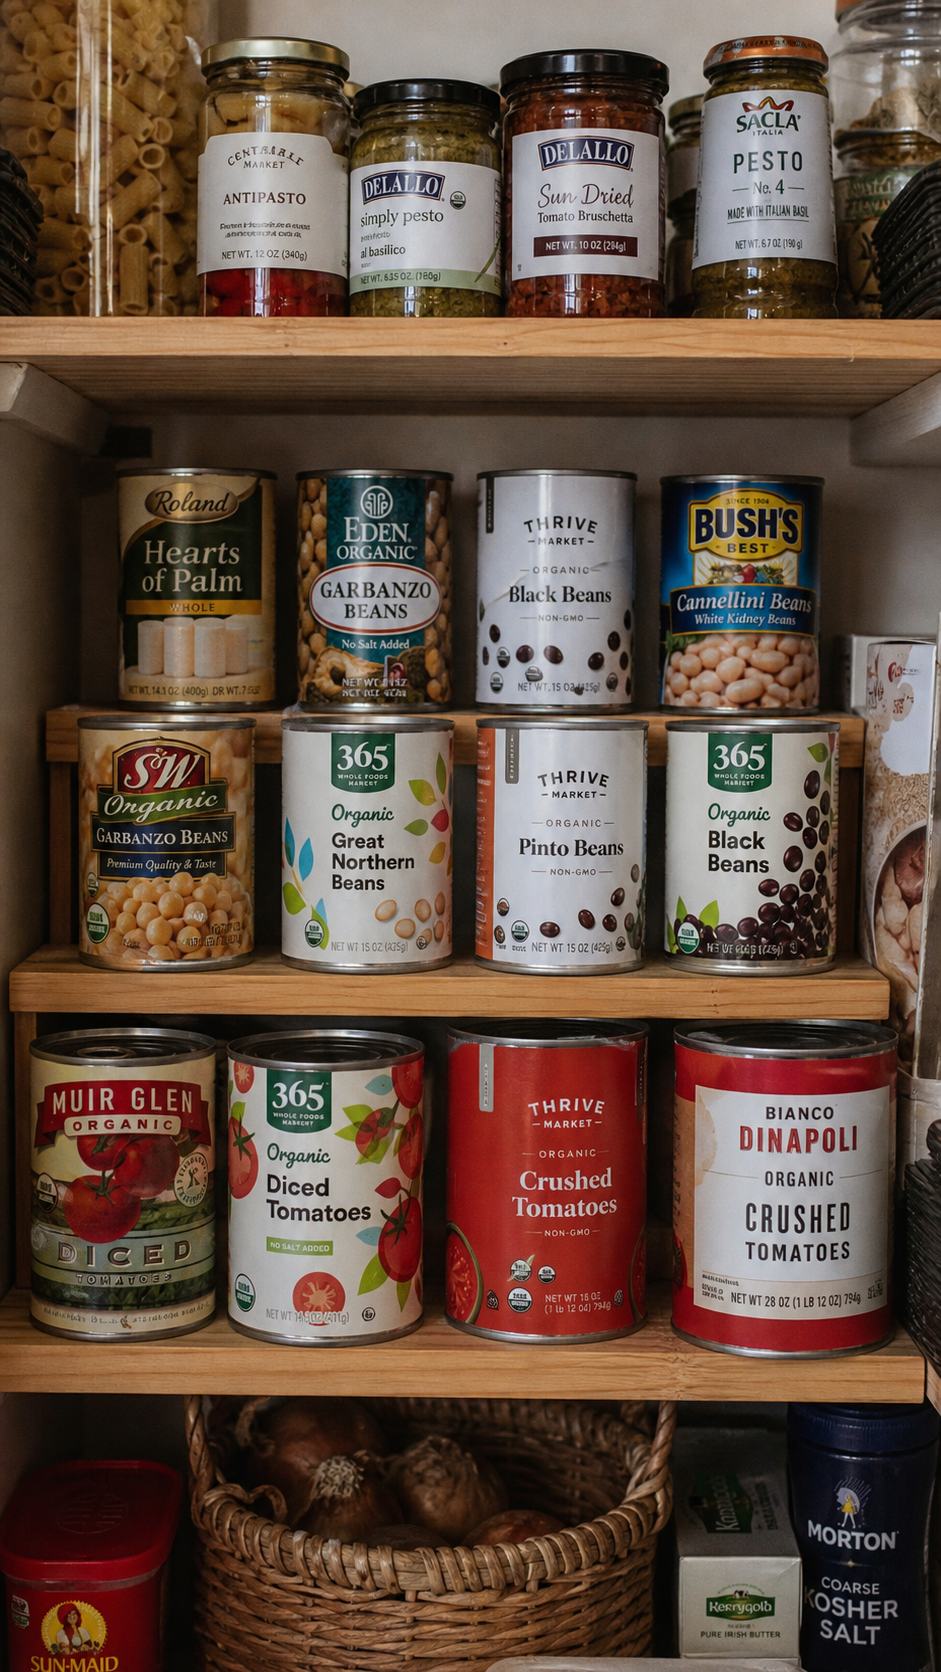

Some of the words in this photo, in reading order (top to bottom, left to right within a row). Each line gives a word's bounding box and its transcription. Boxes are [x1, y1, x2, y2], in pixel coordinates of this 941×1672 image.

[543, 140, 629, 165] DELALLO
[734, 151, 803, 174] PESTO
[364, 173, 439, 199] DELALLO
[775, 179, 785, 195] 4
[223, 192, 306, 205] ANTIPASTO
[538, 184, 577, 208] Sun
[581, 184, 634, 208] Dried
[361, 209, 399, 227] simply
[403, 210, 444, 226] pesto
[538, 212, 575, 223] Tomato
[578, 210, 633, 223] Bruschetta
[728, 207, 744, 220] MADE
[746, 206, 764, 218] WITH
[766, 205, 791, 217] ITALIAN
[793, 205, 809, 218] BASIL
[361, 247, 366, 258] al
[369, 245, 406, 257] basilico
[546, 241, 560, 250] NET
[562, 241, 577, 249] WT.
[579, 241, 588, 249] 10
[591, 240, 601, 249] OZ
[735, 240, 746, 250] NET
[748, 240, 760, 248] WT.
[772, 238, 781, 248] OZ
[222, 251, 236, 260] NET
[238, 250, 252, 258] WT.
[255, 250, 264, 258] 12
[267, 250, 279, 258] OZ
[282, 251, 307, 261] (340g)
[361, 275, 369, 284] NET
[154, 490, 229, 515] Roland
[343, 517, 409, 543] EDEN
[524, 515, 598, 534] THRIVE
[695, 507, 799, 545] BUSH'S
[538, 537, 585, 545] MARKET
[727, 543, 769, 554] BEST
[144, 540, 240, 565] Hearts
[336, 545, 415, 560] ORGANIC
[533, 566, 590, 574] ORGANIC
[142, 568, 167, 592] of
[172, 568, 243, 593] Palm
[321, 582, 431, 599] GARBANZO
[509, 585, 557, 603] Black
[562, 586, 612, 603] Beans
[170, 603, 215, 612] WHOLE
[677, 591, 765, 612] Cannellini
[770, 593, 812, 613] Beans
[344, 604, 408, 619] BEANS
[695, 614, 724, 625] White
[726, 613, 765, 627] Kidney
[768, 614, 796, 626] Beans
[342, 639, 356, 649] No
[358, 639, 378, 649] Salt
[379, 639, 410, 649] Added
[342, 678, 362, 686] NET
[518, 682, 532, 692] NET
[552, 682, 561, 692] 15
[168, 686, 179, 696] OZ
[182, 686, 208, 697] (400g)
[213, 686, 225, 696] DR
[337, 741, 389, 771] 365
[713, 741, 766, 771] 365
[537, 770, 610, 788] THRIVE
[103, 791, 218, 823] Organic
[708, 803, 771, 827] Organic
[331, 804, 394, 828] Organic
[546, 819, 602, 827] ORGANIC
[96, 828, 176, 845] GARBANZO
[180, 829, 228, 845] BEANS
[331, 832, 384, 849] Great
[708, 830, 765, 850] Black
[519, 838, 569, 856] Pinto
[574, 839, 624, 856] Beans
[106, 858, 143, 870] Premium
[146, 858, 181, 873] Quality
[184, 860, 193, 869] &
[194, 858, 216, 868] Taste
[332, 853, 415, 870] Northern
[708, 853, 770, 873] Beans
[550, 868, 596, 876] NON-GMO
[332, 874, 385, 890] Beans
[331, 941, 344, 951] NET
[347, 942, 358, 951] WT
[361, 942, 370, 951] 15
[372, 942, 383, 951] OZ
[531, 942, 548, 952] NET
[550, 943, 563, 952] WT
[567, 943, 576, 952] 15
[577, 943, 589, 952] OZ
[52, 1087, 115, 1115] MUIR
[131, 1087, 193, 1114] GLEN
[271, 1080, 324, 1112] 365
[528, 1098, 605, 1117] THRIVE
[766, 1106, 834, 1120] BIANCO
[72, 1119, 173, 1132] ORGANIC
[544, 1119, 592, 1129] MARKET
[739, 1125, 857, 1154] DINAPOLI
[267, 1142, 331, 1170] Organic
[539, 1149, 596, 1159] ORGANIC
[267, 1174, 330, 1197] Diced
[519, 1167, 613, 1191] Crushed
[765, 1171, 834, 1187] ORGANIC
[266, 1199, 371, 1223] Tomatoes
[511, 1196, 618, 1218] Tomatoes
[745, 1202, 851, 1234] CRUSHED
[544, 1228, 590, 1237] NON-GMO
[57, 1240, 192, 1268] DICED
[282, 1243, 300, 1252] SALT
[745, 1241, 851, 1262] TOMATOES
[545, 1294, 562, 1303] NET
[564, 1293, 577, 1303] WT
[731, 1292, 748, 1304] NET
[749, 1294, 763, 1306] WT
[765, 1295, 776, 1308] 28
[779, 1296, 790, 1308] OZ
[793, 1296, 801, 1309] (1
[804, 1296, 814, 1308] LB
[818, 1295, 826, 1307] 12
[828, 1294, 842, 1308] OZ)
[266, 1308, 280, 1319] NET
[280, 1310, 293, 1321] WT
[545, 1303, 554, 1314] (1
[568, 1304, 577, 1313] 12
[807, 1519, 897, 1551] MORTON
[821, 1576, 880, 1595] COARSE
[709, 1601, 772, 1615] Kerrygold
[804, 1586, 899, 1620] KOSHER
[819, 1618, 881, 1646] SALT
[30, 1656, 119, 1672] SUN-MAID
